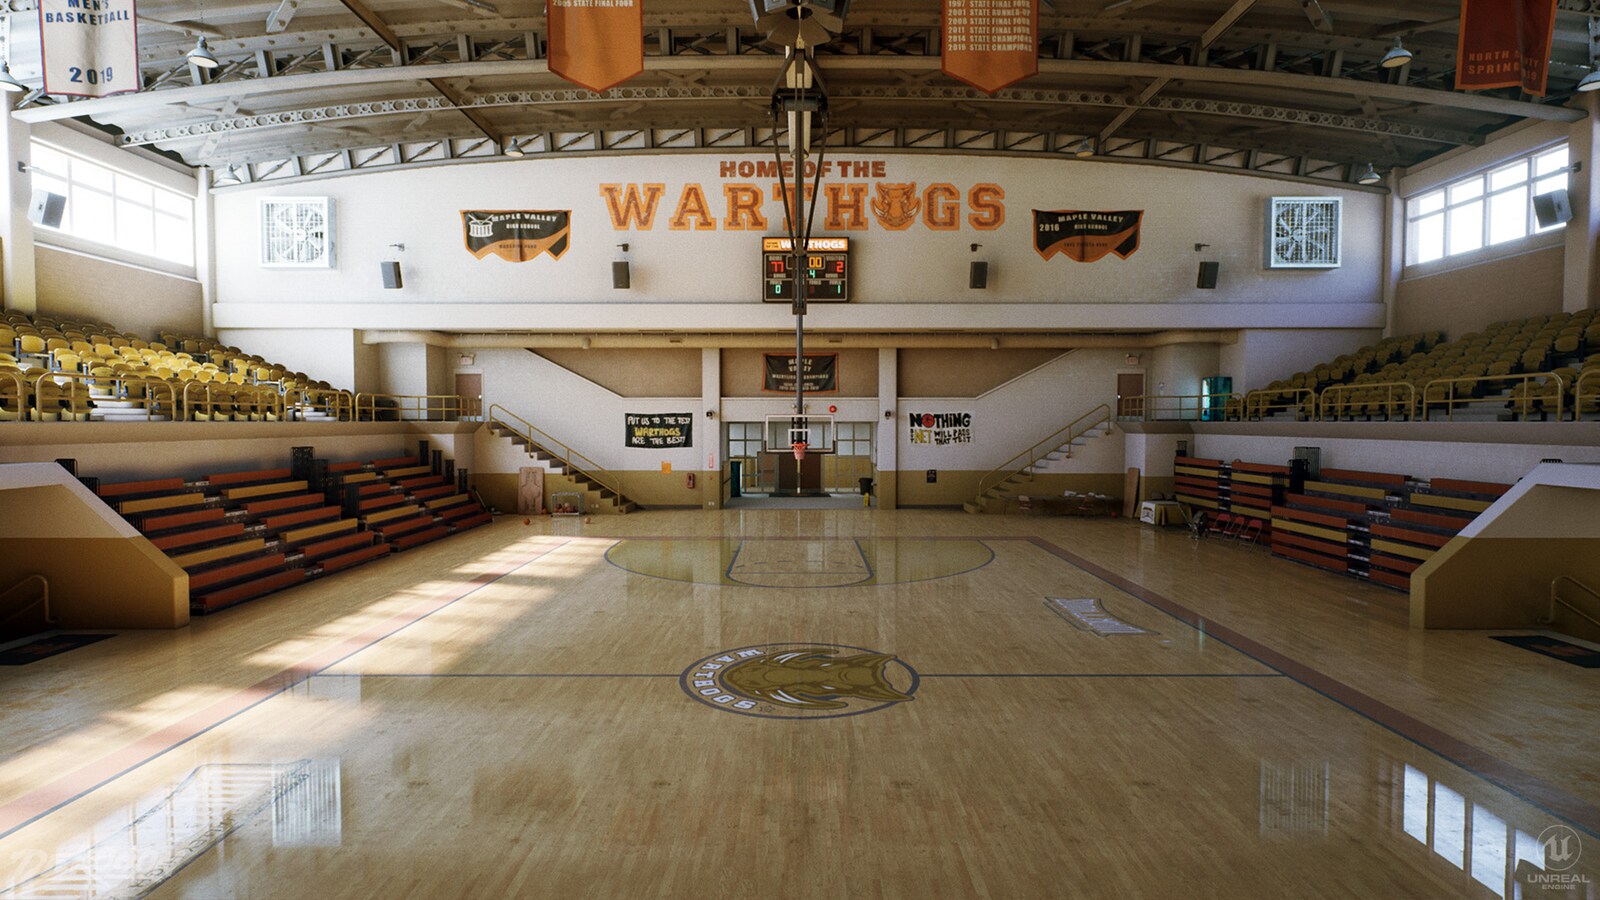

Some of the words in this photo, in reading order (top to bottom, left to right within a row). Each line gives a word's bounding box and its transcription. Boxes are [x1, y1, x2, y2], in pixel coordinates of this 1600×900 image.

[46, 10, 130, 25] BASKETBALL
[948, 26, 966, 34] 2011
[969, 26, 990, 34] STATE
[991, 26, 1011, 34] FINAL
[1013, 26, 1031, 34] FOUR
[1468, 50, 1510, 61] NORTH
[1467, 62, 1520, 75] SPRING
[69, 67, 114, 85] 2019
[720, 161, 794, 178] HOME
[803, 161, 832, 178] OF
[837, 161, 887, 178] THE
[491, 213, 521, 222] MAPLE
[524, 213, 558, 222] VALLEY
[1058, 213, 1088, 222] MAPLE
[1090, 213, 1124, 222] VALLEY
[836, 261, 844, 273] 2
[809, 269, 816, 279] 4
[775, 284, 781, 294] 0
[627, 416, 640, 425] PUT
[640, 417, 650, 425] US
[663, 416, 677, 425] THE
[634, 426, 681, 437] WARTHOGS
[914, 429, 933, 444] NET
[933, 430, 952, 438] WILL
[631, 437, 645, 445] ARE
[650, 437, 664, 446] THE
[934, 437, 952, 445] THAT
[692, 649, 766, 710] WARTHOGS
